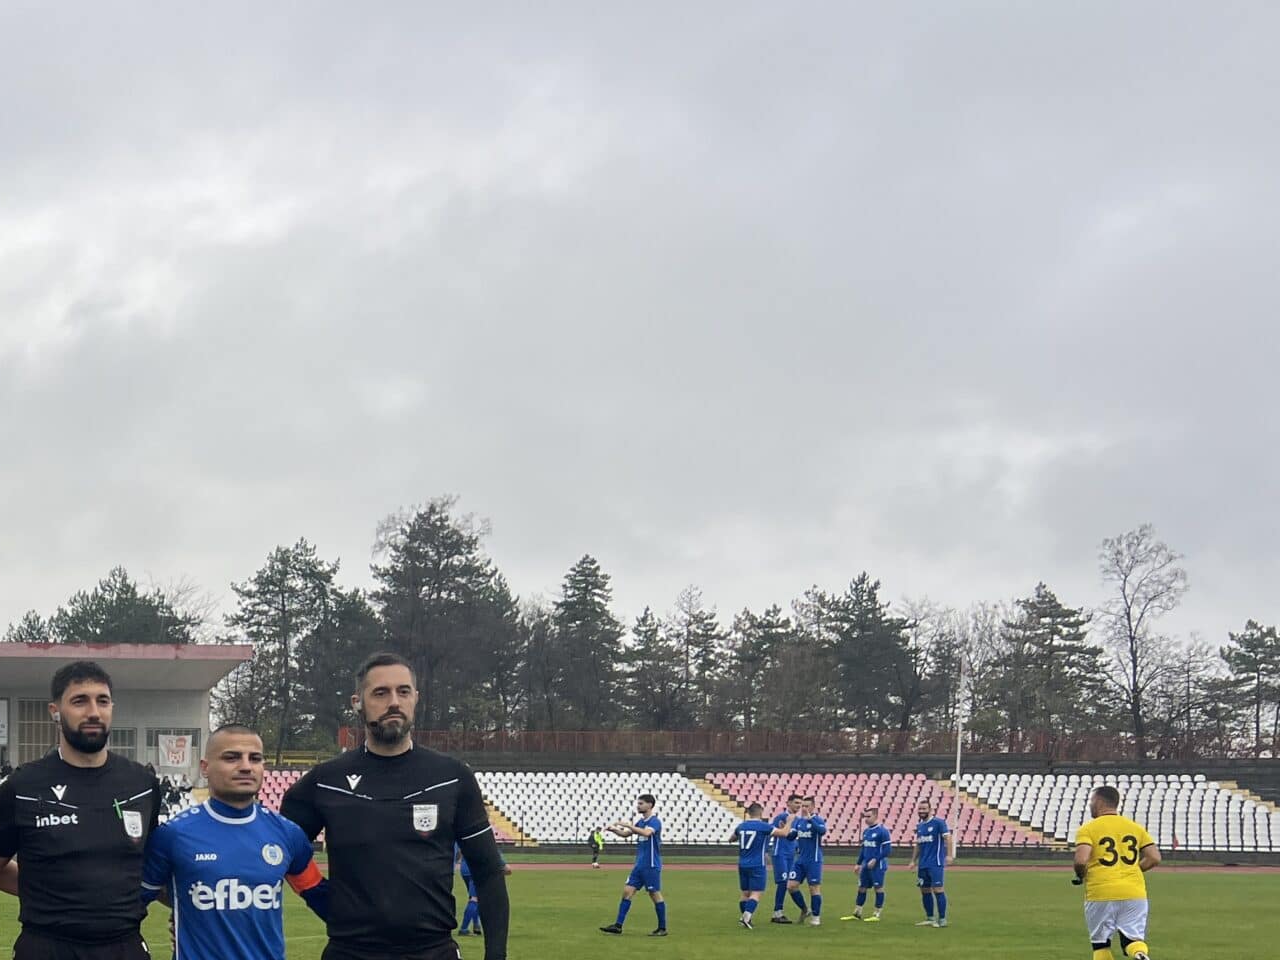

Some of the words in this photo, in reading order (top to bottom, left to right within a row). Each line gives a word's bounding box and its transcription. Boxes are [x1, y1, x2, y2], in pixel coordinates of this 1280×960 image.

[35, 813, 79, 828] inbet
[739, 831, 757, 850] 17
[195, 853, 217, 861] JAKO
[1098, 835, 1139, 867] 33
[188, 878, 284, 911] efbet
